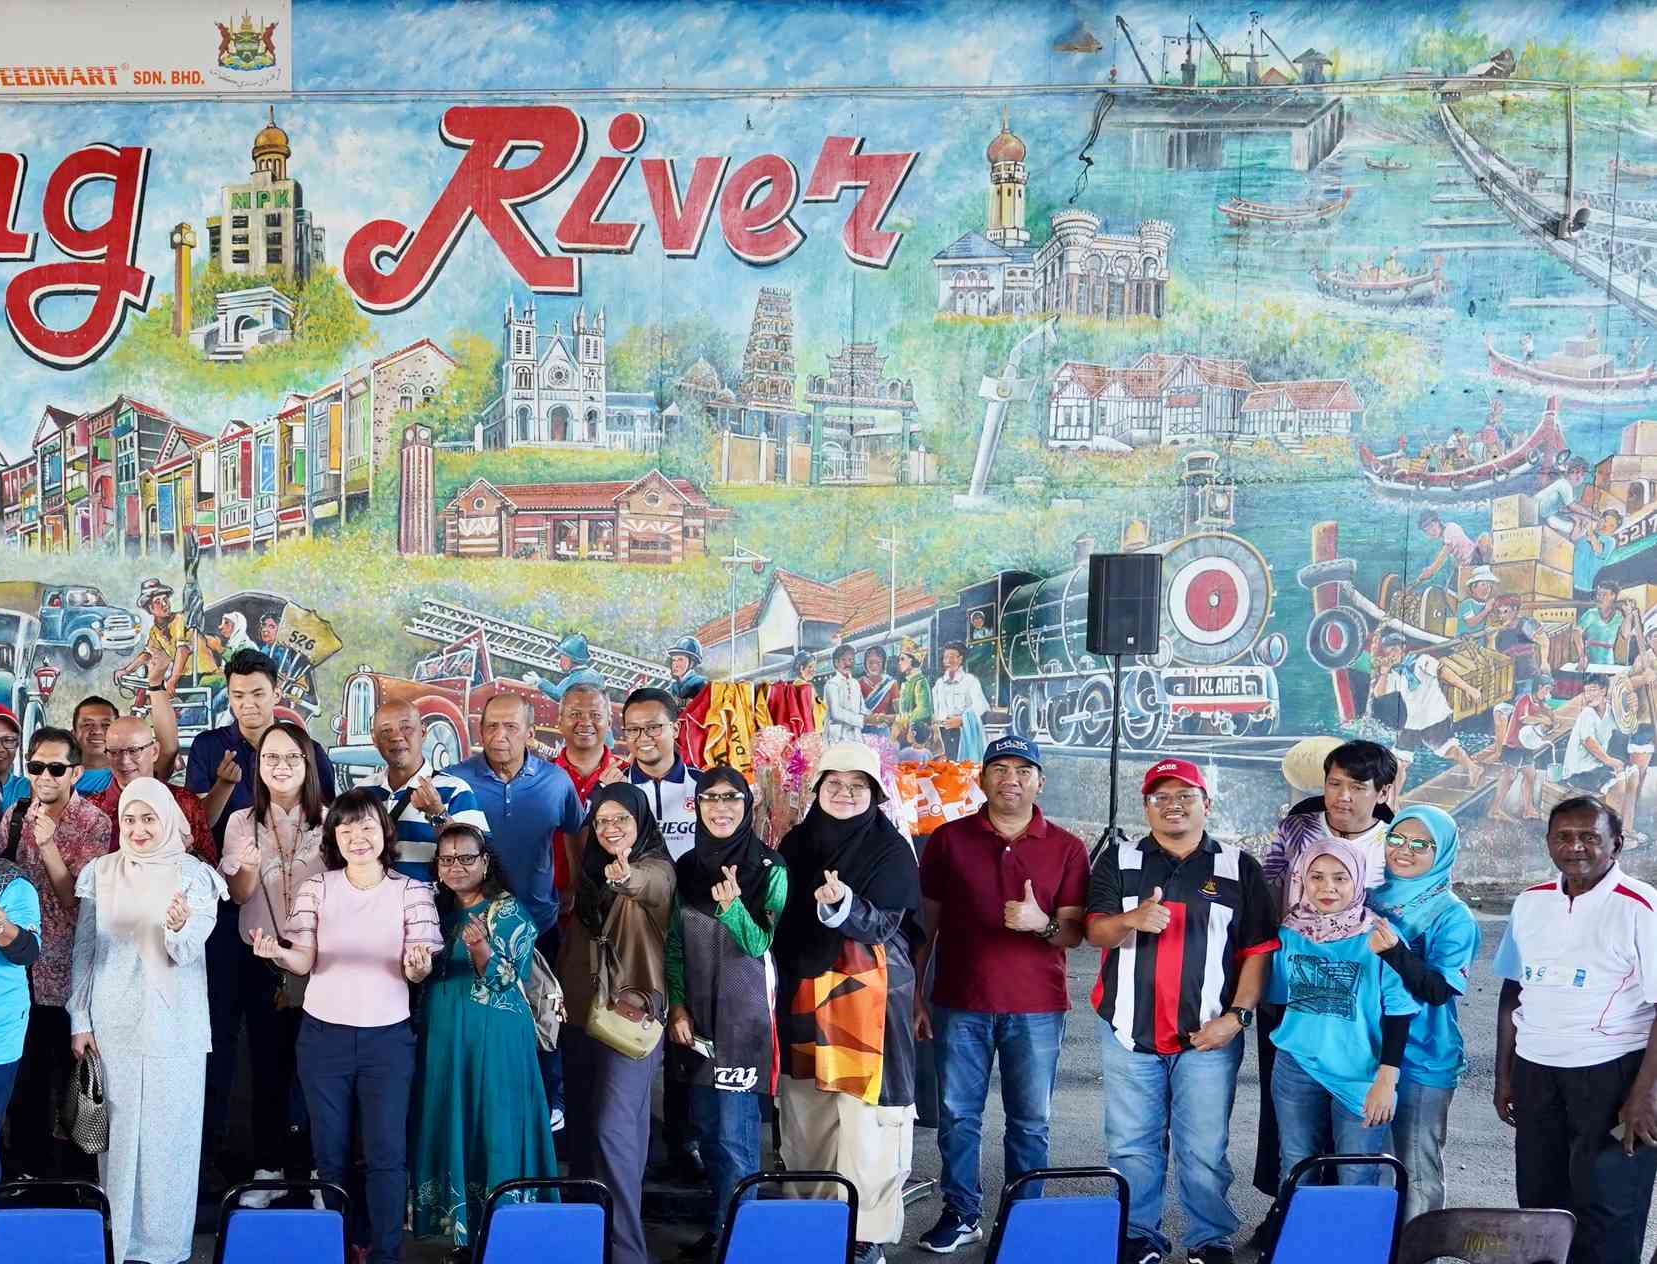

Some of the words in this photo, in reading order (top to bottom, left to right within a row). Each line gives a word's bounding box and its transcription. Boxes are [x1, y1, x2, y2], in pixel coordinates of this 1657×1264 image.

[133, 70, 166, 85] SDN.
[171, 70, 204, 85] BHD.
[343, 105, 920, 315] River
[288, 630, 316, 651] 526
[1199, 677, 1240, 694] KLANG
